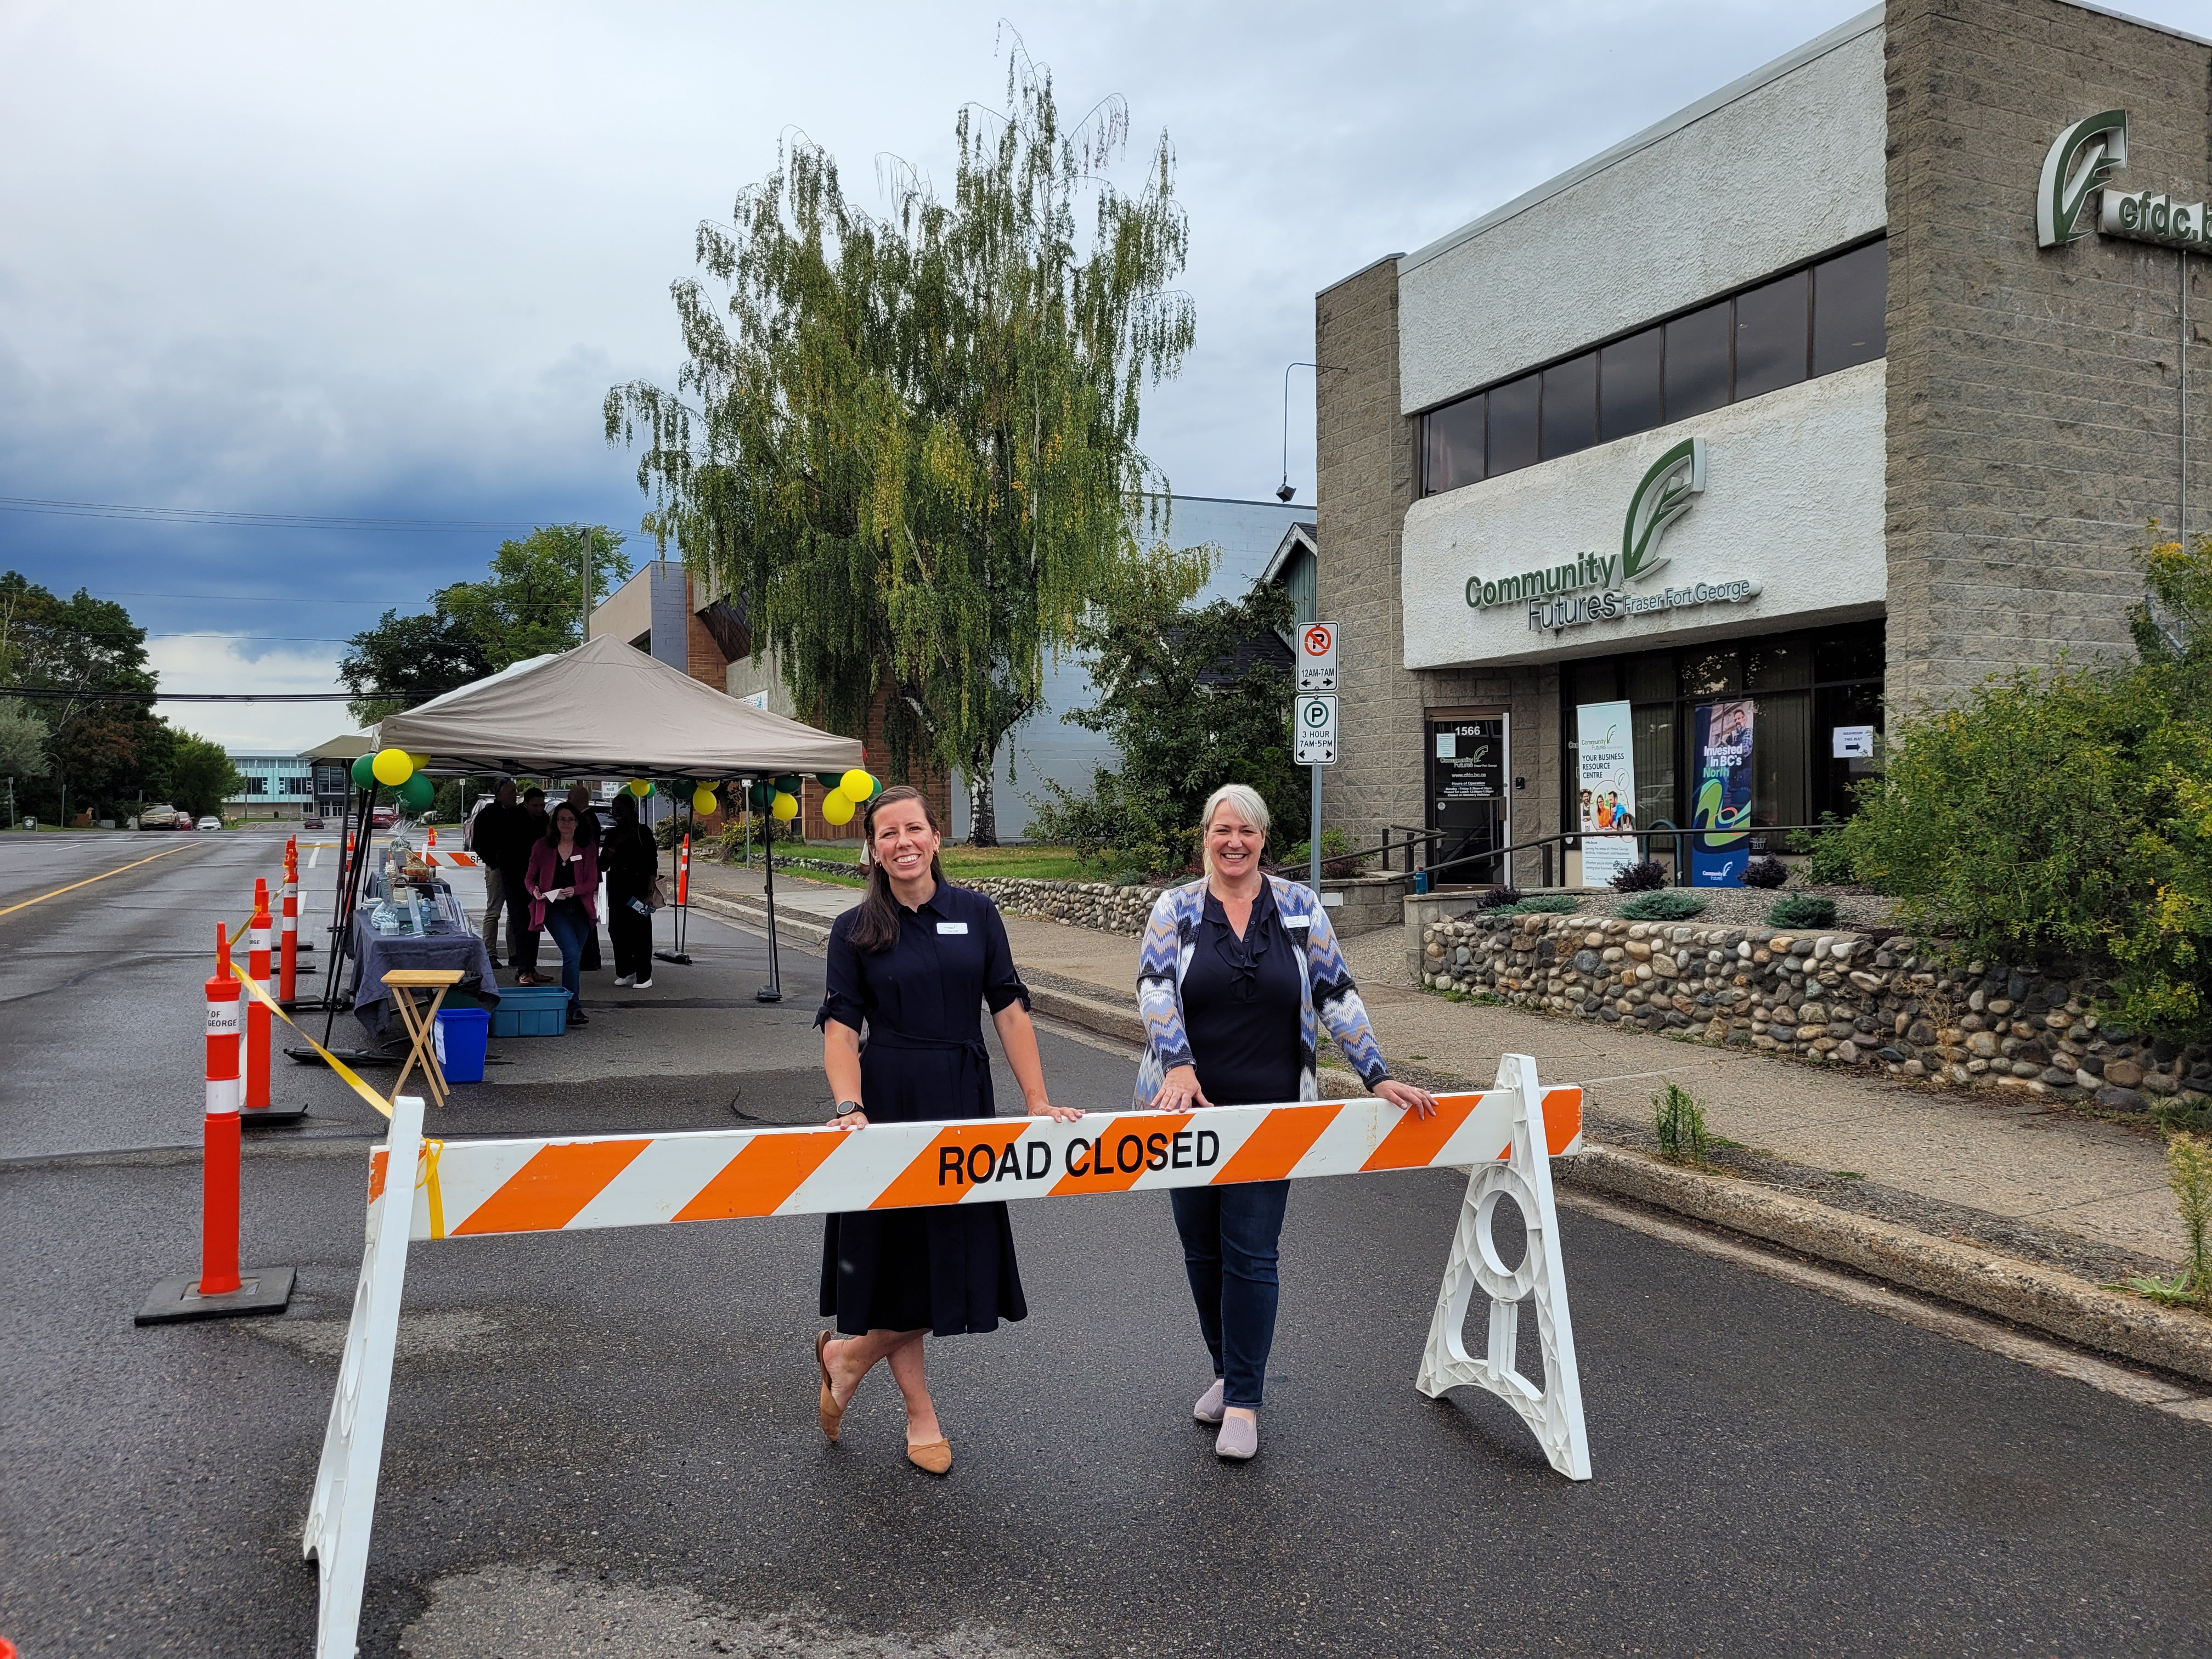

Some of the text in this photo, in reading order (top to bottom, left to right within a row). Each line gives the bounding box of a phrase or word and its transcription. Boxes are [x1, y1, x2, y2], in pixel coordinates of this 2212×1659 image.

[1465, 551, 1618, 608] Community
[1528, 580, 1750, 631] Futures Fraser Fort George
[1301, 668, 1335, 678] 12AM-7AM
[1455, 726, 1481, 736] 1566
[1703, 743, 1743, 757] Invested
[1599, 753, 1624, 761] BUSINESS
[1710, 755, 1742, 766] in BC's
[1703, 766, 1730, 778] North
[938, 1130, 1220, 1186] ROAD CLOSED
